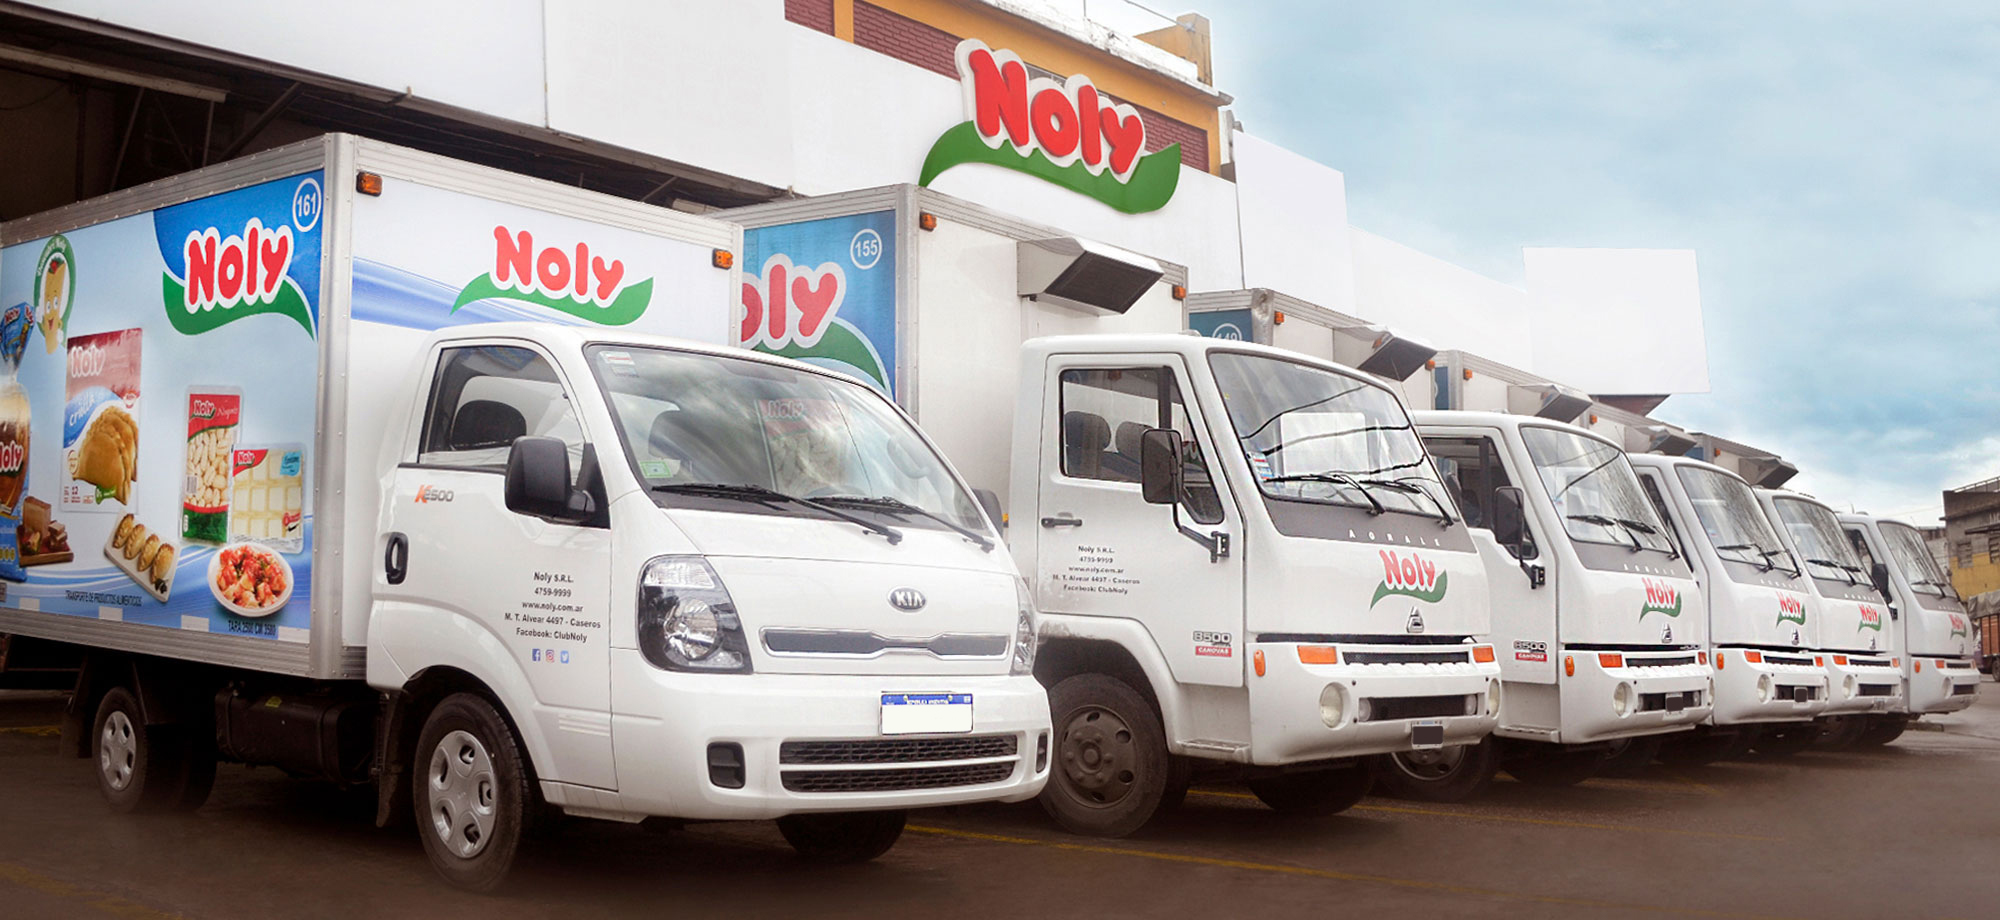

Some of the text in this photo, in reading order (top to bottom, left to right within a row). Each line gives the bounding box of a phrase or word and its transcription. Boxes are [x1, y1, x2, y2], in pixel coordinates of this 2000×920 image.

[966, 47, 1145, 175] Noly
[296, 193, 317, 217] 161
[855, 239, 878, 257] 155
[187, 224, 290, 307] Noly
[493, 225, 625, 301] Noly
[193, 400, 214, 416] Noly
[1078, 545, 1095, 554] Noly
[1378, 549, 1436, 588] Noly
[534, 571, 574, 584] Noly S.R.L.
[534, 586, 572, 597] 4759-9999
[894, 590, 923, 606] KIA
[1641, 576, 1675, 606] Noly
[522, 601, 583, 612] www.noly.com.ar
[1776, 591, 1801, 615] Noly
[504, 612, 513, 621] M.
[515, 613, 521, 622] T.
[522, 614, 545, 624] Alvear
[570, 618, 601, 629] Caseros
[1858, 603, 1878, 623] Noly
[516, 627, 588, 643] Facebook: ClubNoly
[1193, 631, 1232, 643] 8500
